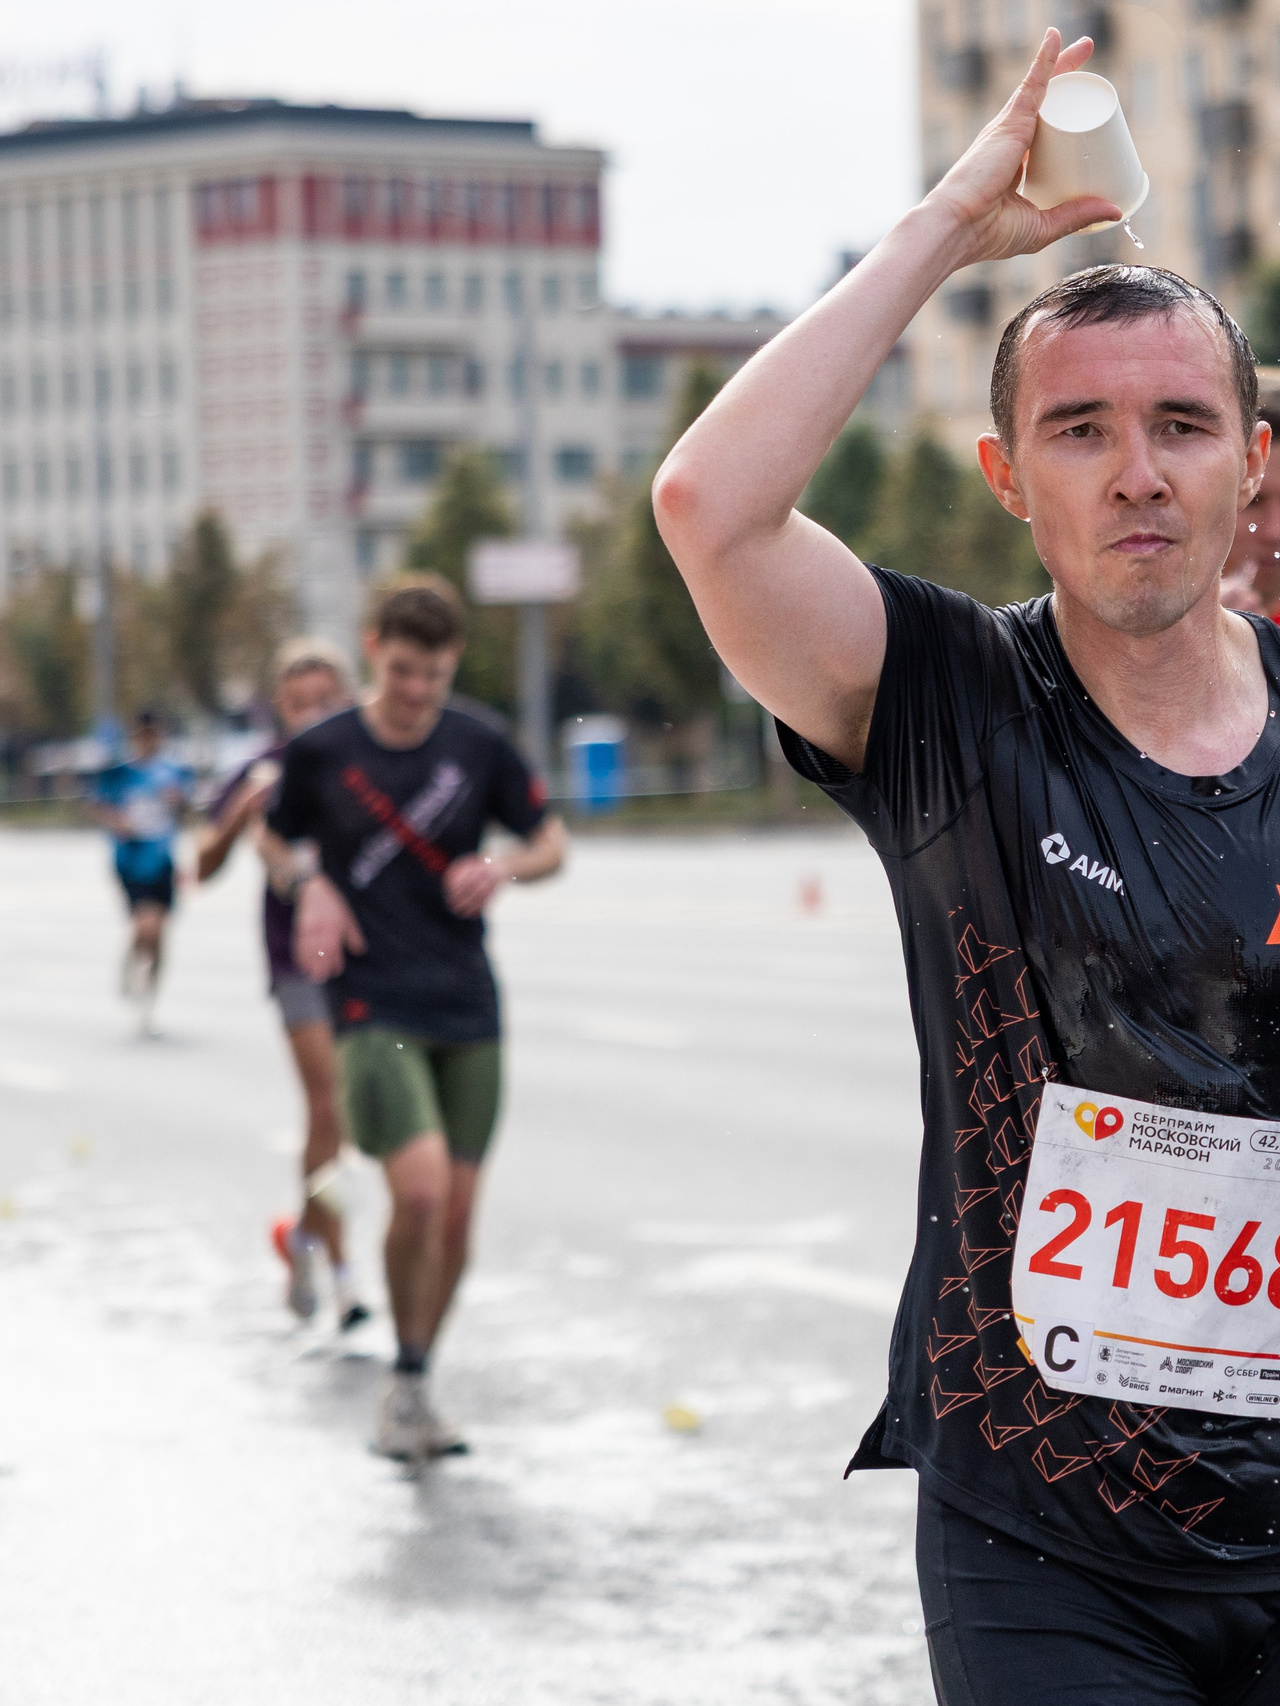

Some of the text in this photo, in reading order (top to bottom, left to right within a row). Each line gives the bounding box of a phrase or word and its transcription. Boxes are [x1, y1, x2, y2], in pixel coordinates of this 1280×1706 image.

[1133, 1111, 1215, 1134] СБЕРПРАЙМ
[1131, 1123, 1241, 1153] МОСКОВСКИЙ
[1128, 1137, 1211, 1163] МАРАФОН
[1176, 1357, 1214, 1369] МОСКОВСКИЙ
[1175, 1365, 1194, 1375] СПОРТ
[1236, 1368, 1259, 1377] СБЕР
[1129, 1382, 1150, 1392] BRICS
[1248, 1395, 1274, 1403] WINLINE
